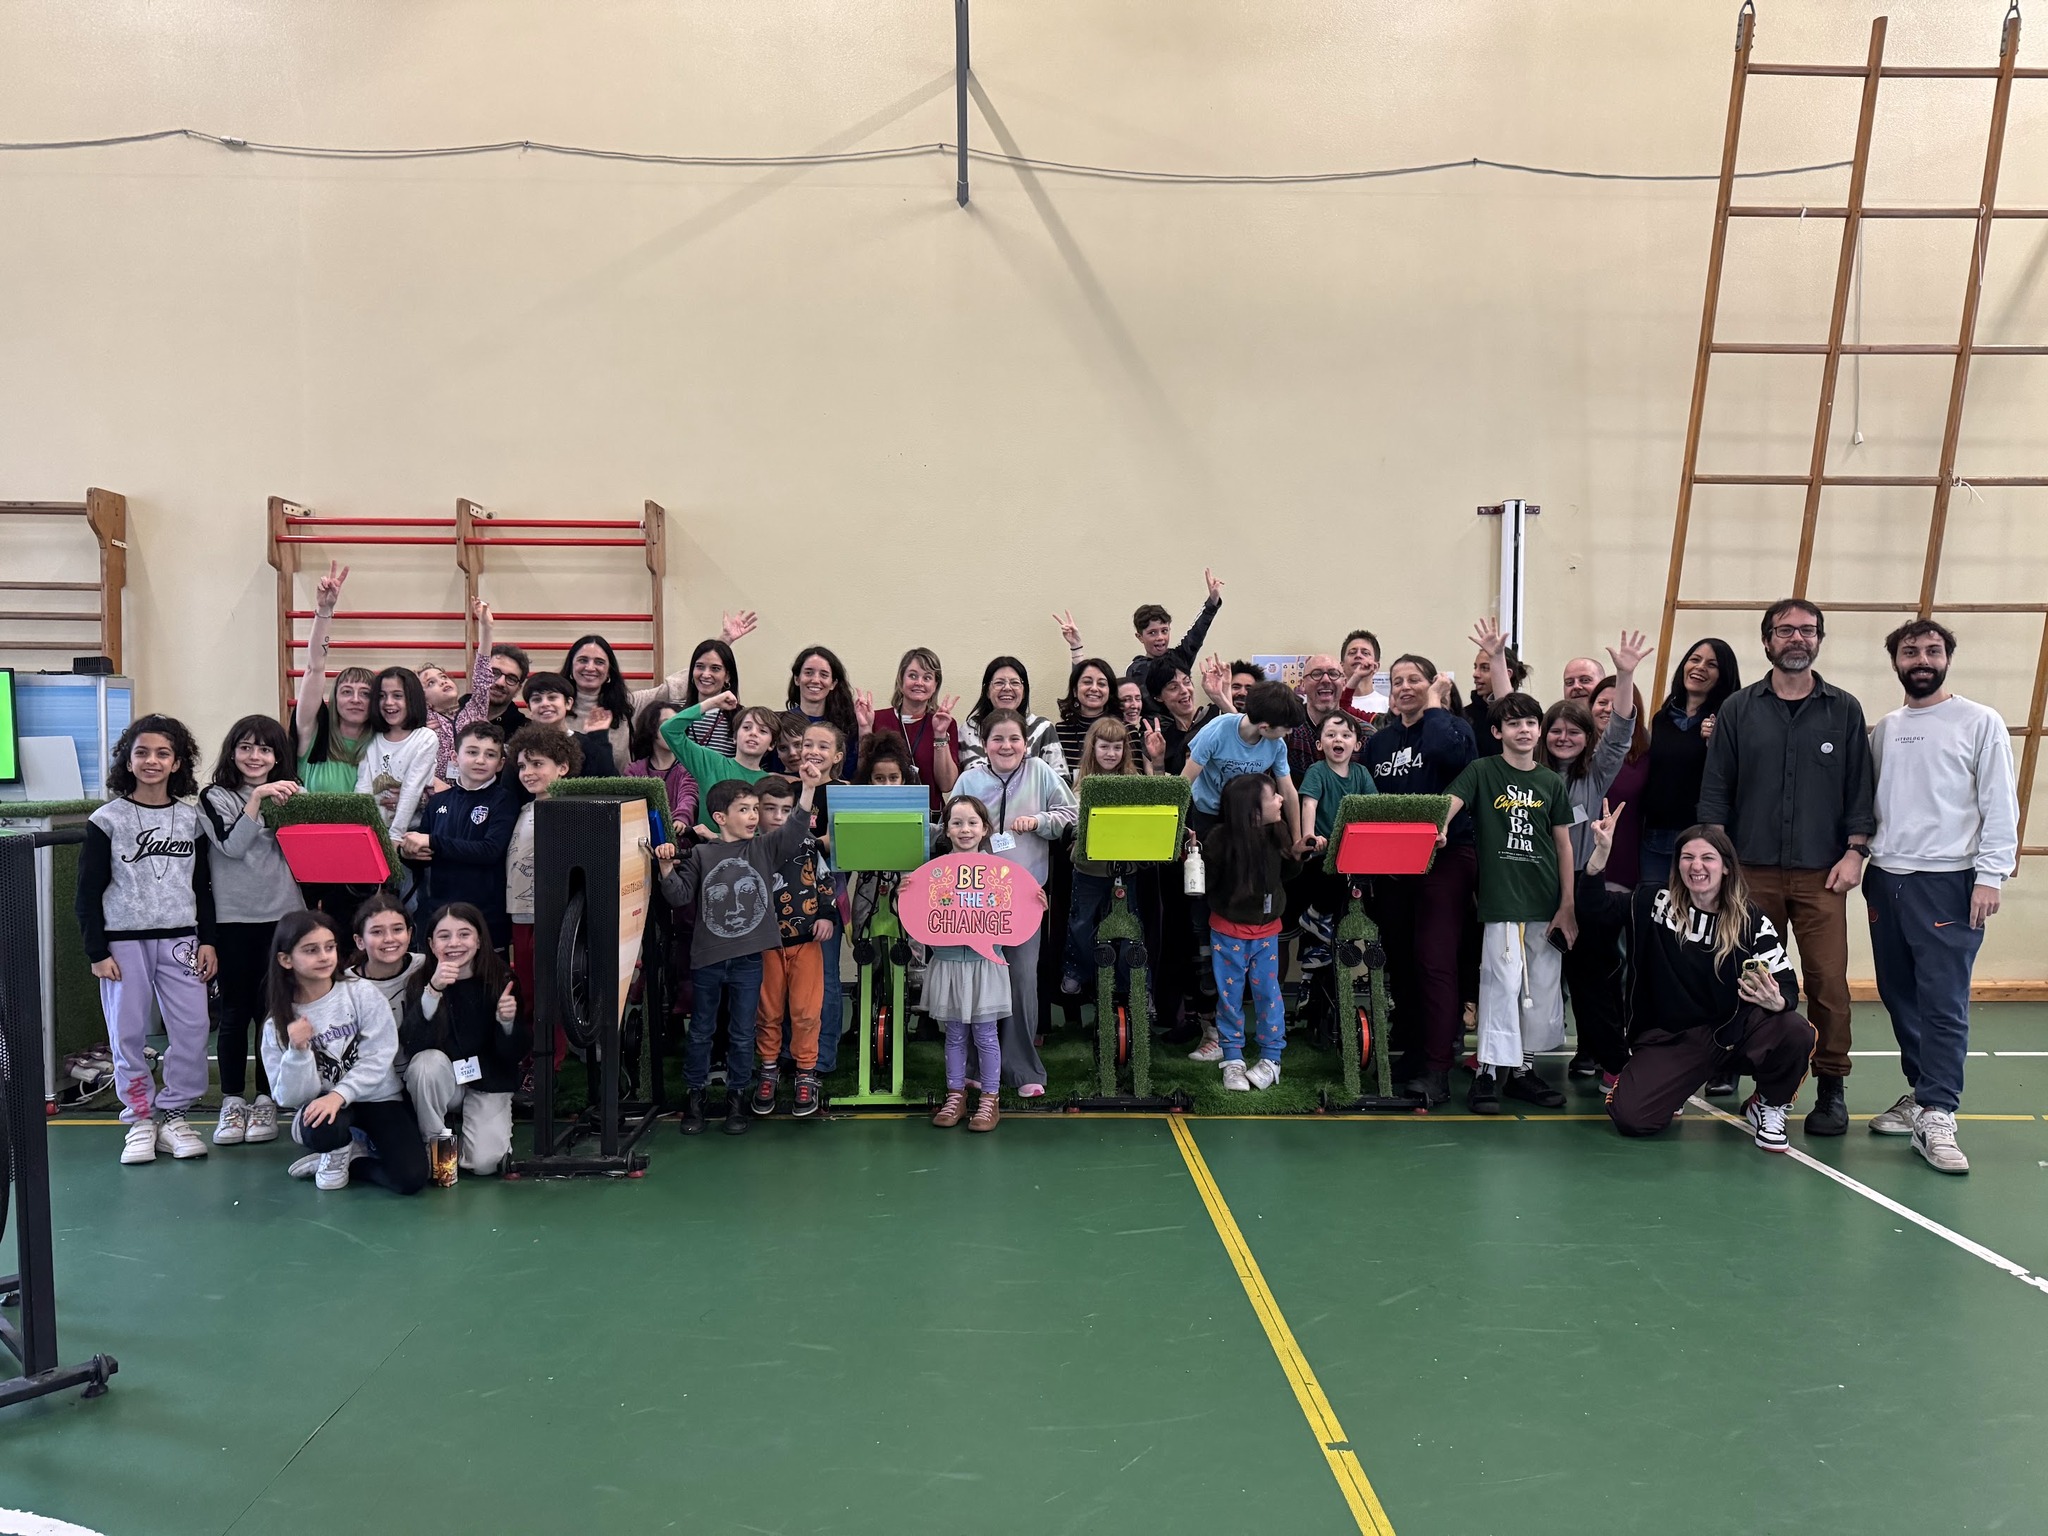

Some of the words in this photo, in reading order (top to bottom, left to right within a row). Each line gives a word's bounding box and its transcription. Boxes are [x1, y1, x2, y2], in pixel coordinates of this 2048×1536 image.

[1509, 816, 1534, 836] Ba
[1506, 832, 1534, 852] hia
[955, 864, 987, 889] BE
[956, 891, 984, 908] THE
[928, 909, 1012, 935] CHANGE
